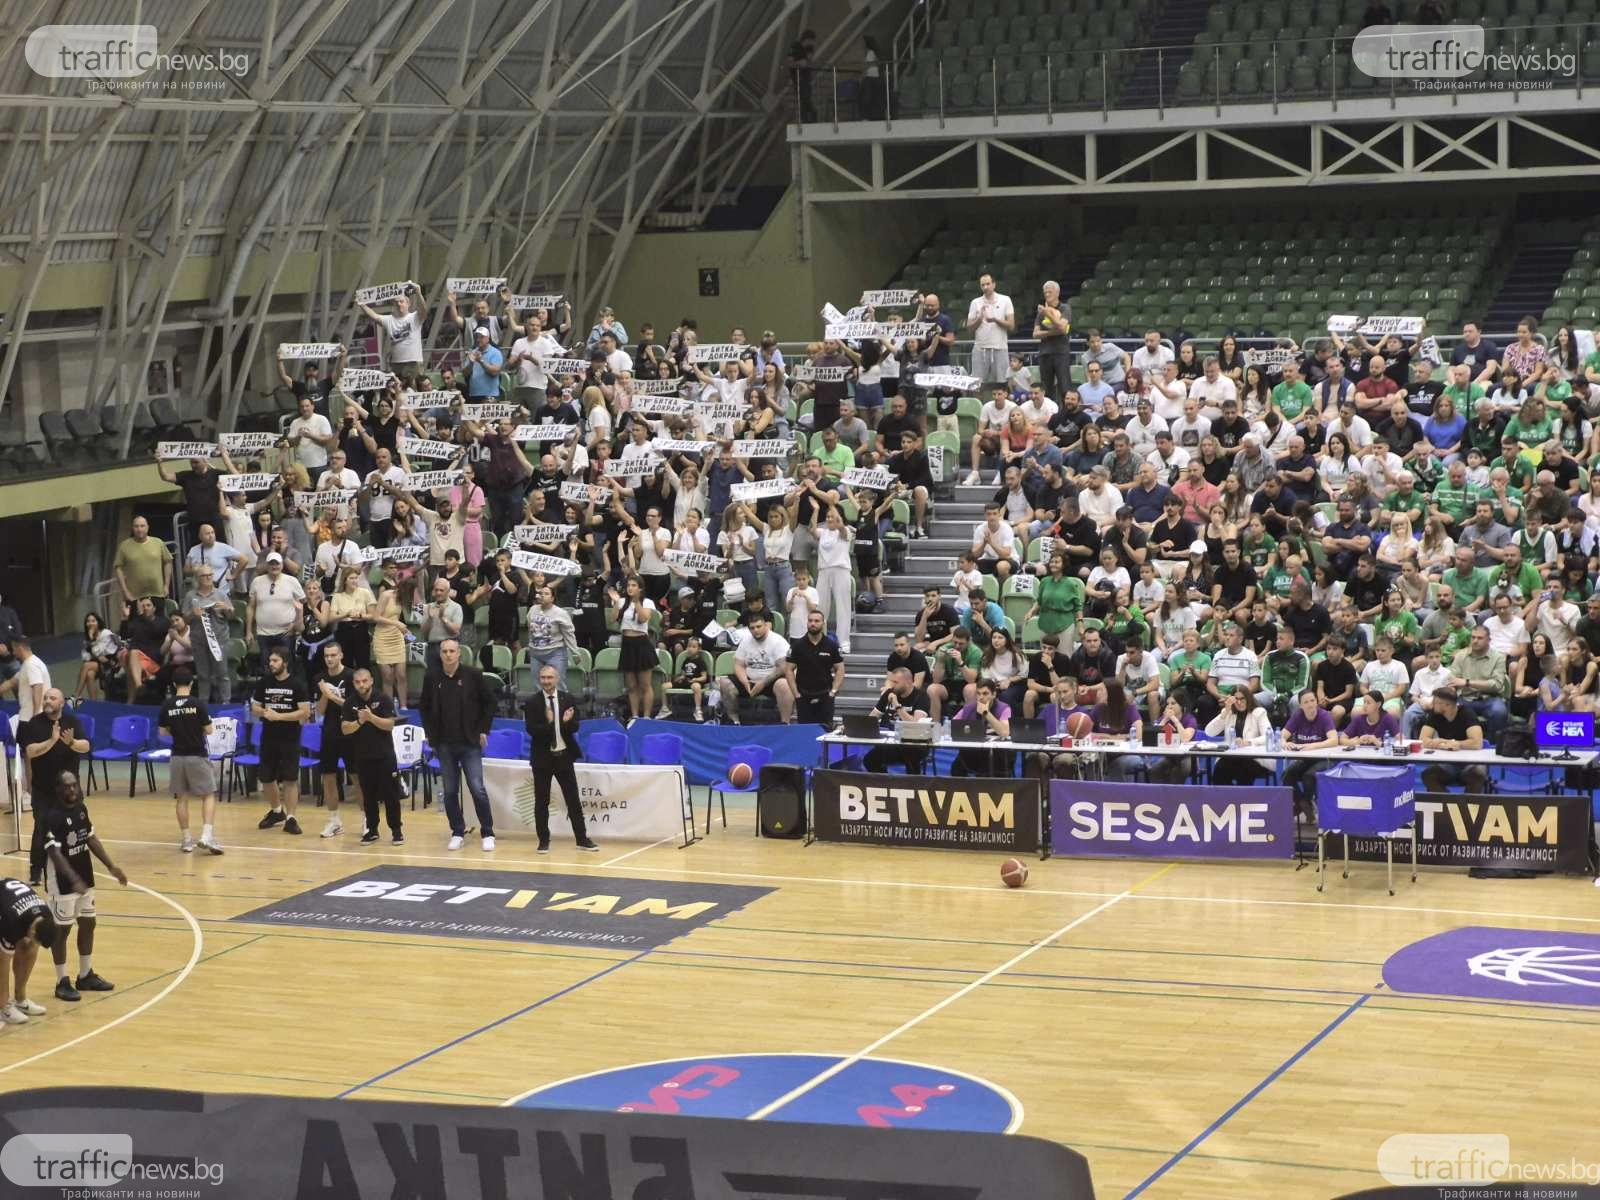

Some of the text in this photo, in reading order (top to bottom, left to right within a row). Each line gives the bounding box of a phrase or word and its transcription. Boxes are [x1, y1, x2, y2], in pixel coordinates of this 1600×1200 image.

[394, 553, 417, 561] ОКРАЙ
[840, 785, 1015, 829] BETVAM
[841, 824, 1015, 845] ХАЗАРТЪТ НОСИ РИСК ОТ РАЗВИТИЕ НА ЗАВИСИМОСТ
[1393, 802, 1558, 845] TVAM
[1355, 840, 1387, 854] ХАЗАРТЪ
[1417, 843, 1437, 857] РИСК
[1440, 844, 1449, 857] ОТ
[1453, 845, 1490, 859] РАЗВИТИЕ
[1492, 846, 1503, 859] НА
[1505, 846, 1558, 861] ЗАВИСИМОСТ
[323, 880, 719, 920] BETVAM
[335, 913, 378, 924] НОСИ
[380, 917, 419, 928] РИСК
[420, 920, 440, 929] ОТ
[444, 921, 517, 935] РАЗВИТИЕ
[519, 928, 535, 937] НА
[540, 929, 646, 944] ЗАВИСИМОСТ
